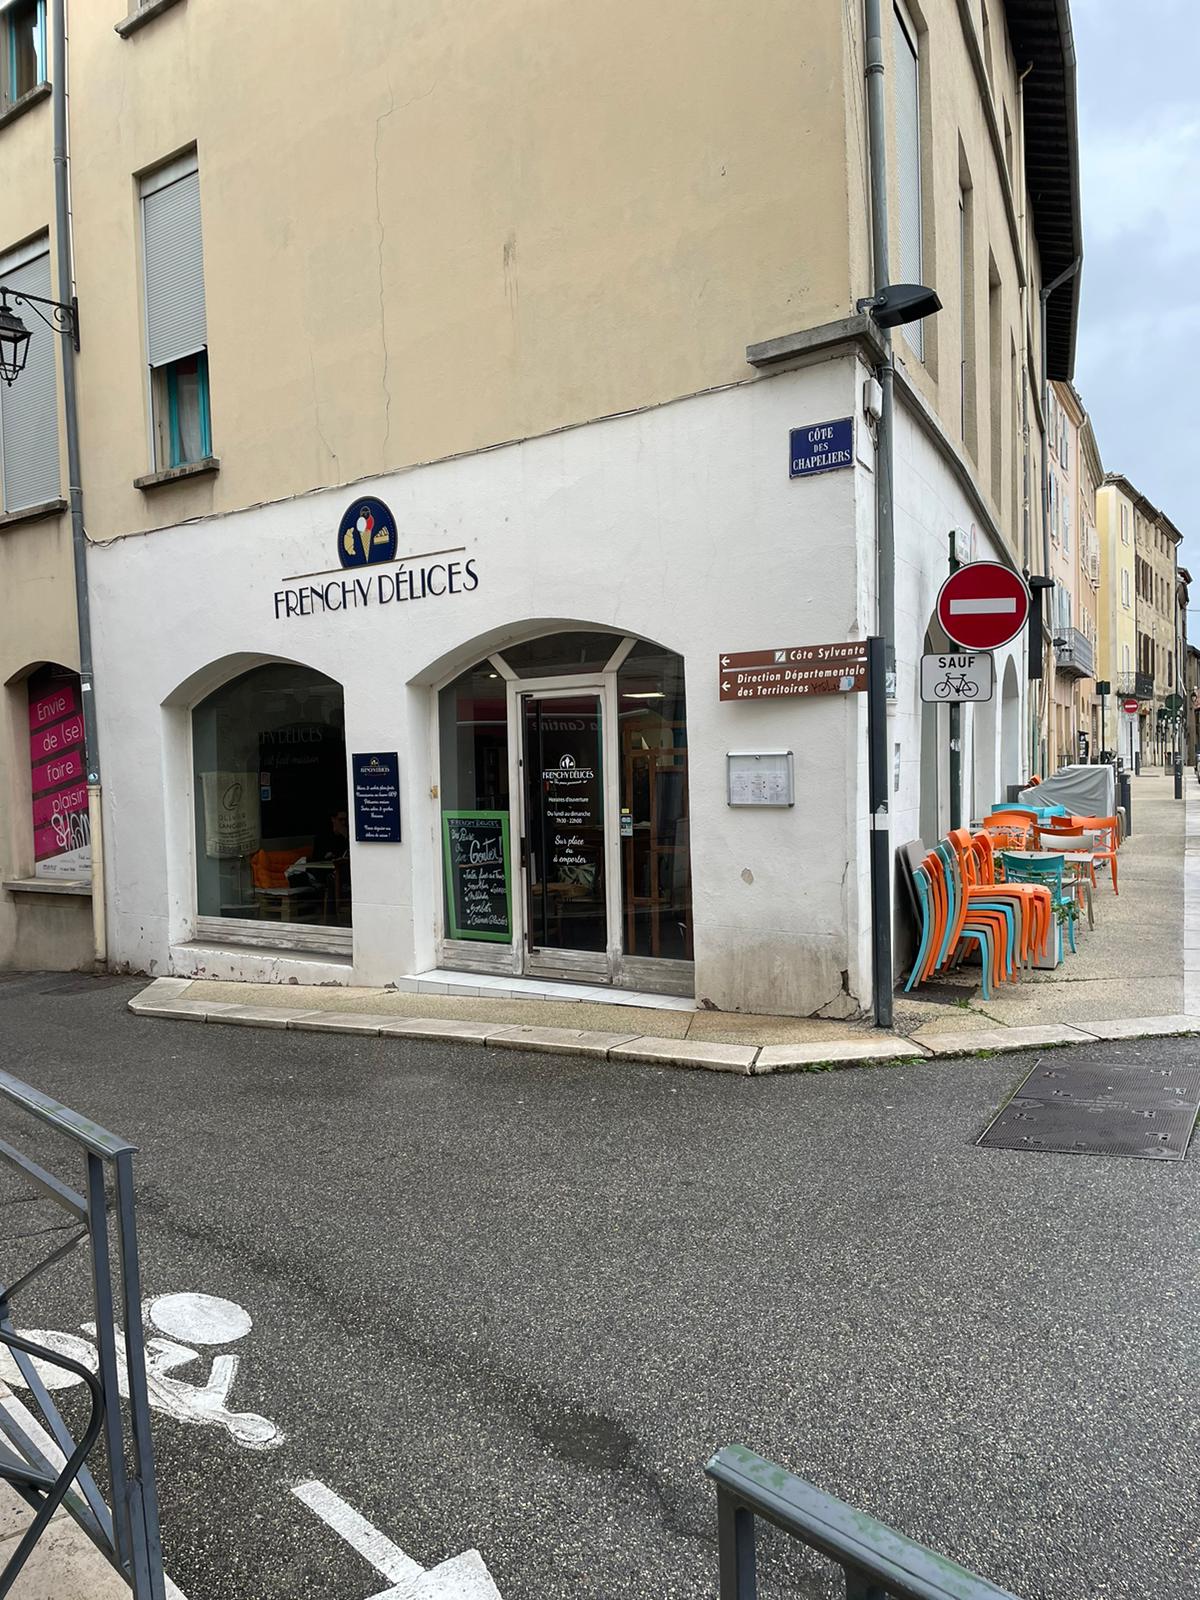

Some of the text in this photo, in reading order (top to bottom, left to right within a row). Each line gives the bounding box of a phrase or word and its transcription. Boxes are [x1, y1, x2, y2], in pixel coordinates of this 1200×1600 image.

[808, 427, 834, 442] CÔTE
[814, 442, 829, 453] DES
[793, 449, 851, 470] CHAPELIERS
[274, 559, 478, 619] FRENCHY DÉLICES
[790, 645, 865, 661] Côte Sylvante
[938, 656, 975, 669] SAUF
[737, 664, 866, 684] Direction Départementale
[737, 686, 753, 697] des
[757, 683, 809, 696] Territoires
[37, 696, 66, 721] Envie
[43, 716, 83, 751] de (se)
[47, 760, 74, 782] faire
[542, 770, 595, 779] FRENCHY DÉLICES
[53, 787, 85, 815] plaisir
[554, 834, 585, 847] Sur place
[559, 854, 587, 866] emporter
